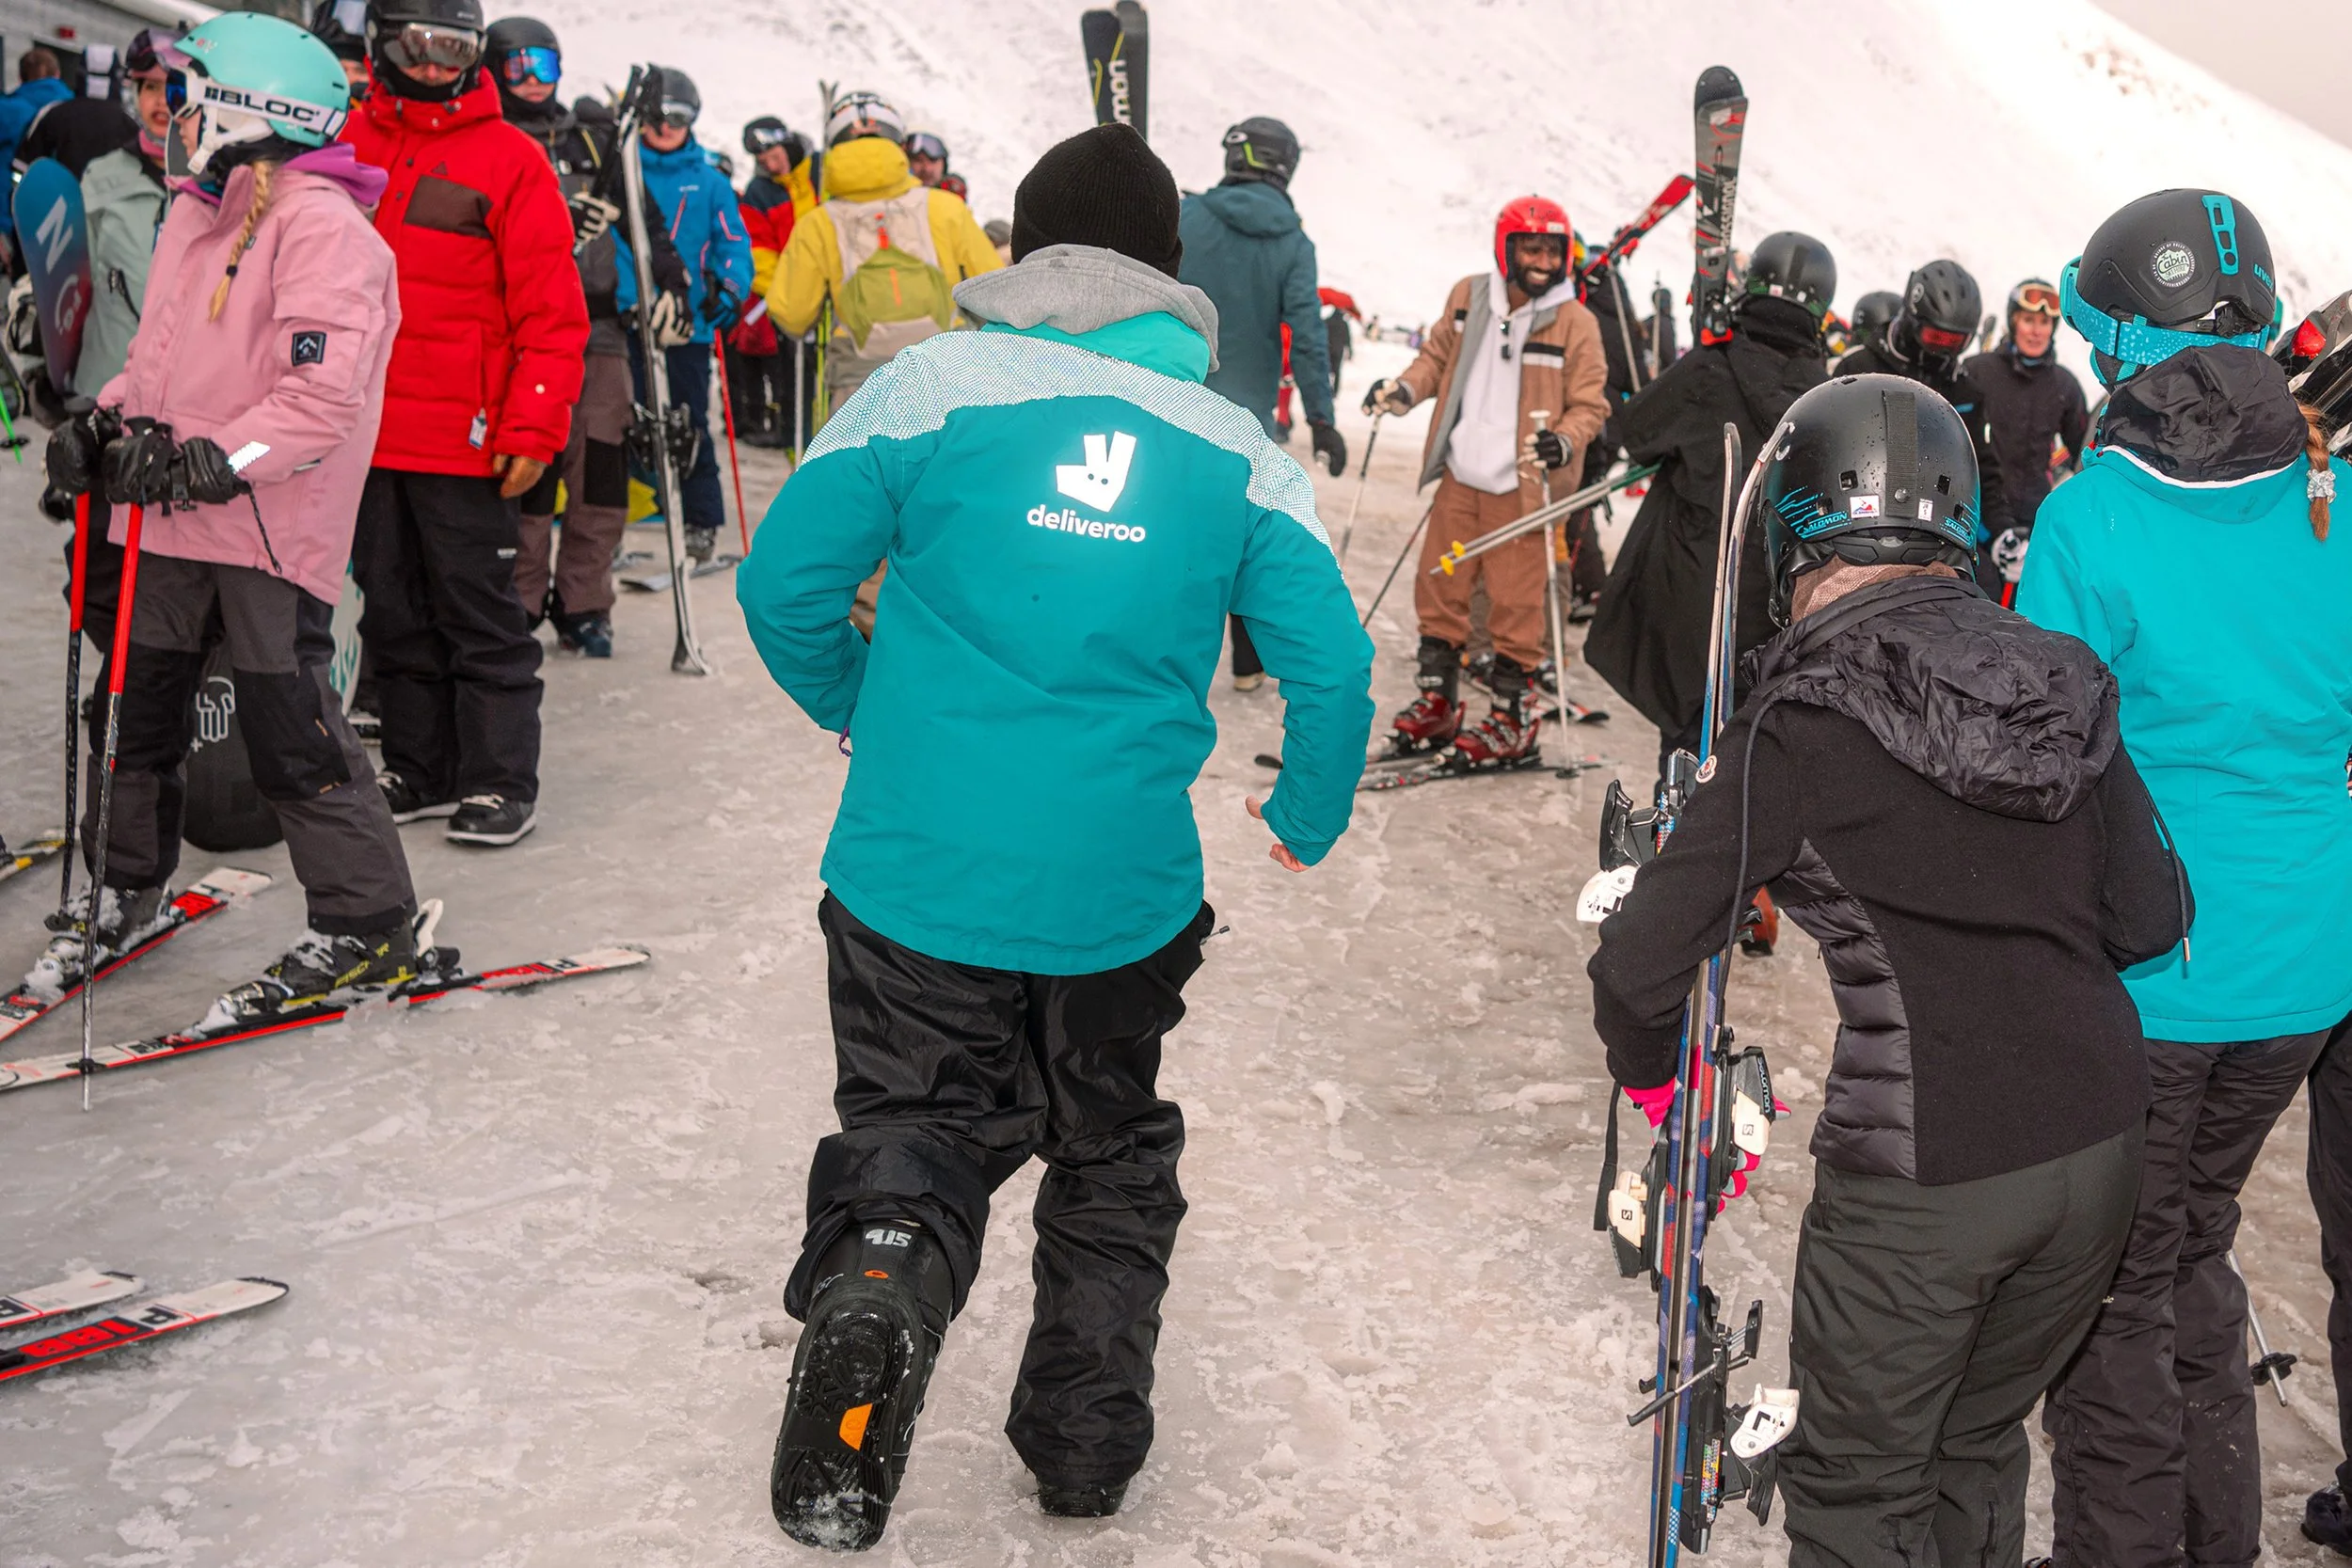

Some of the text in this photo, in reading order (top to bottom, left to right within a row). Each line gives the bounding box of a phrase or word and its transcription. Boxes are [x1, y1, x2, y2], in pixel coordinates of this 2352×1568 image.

[218, 89, 315, 122] BLOC
[2158, 253, 2188, 274] Cabin
[1026, 504, 1146, 543] deliveroo
[1795, 511, 1848, 536] SALOMON
